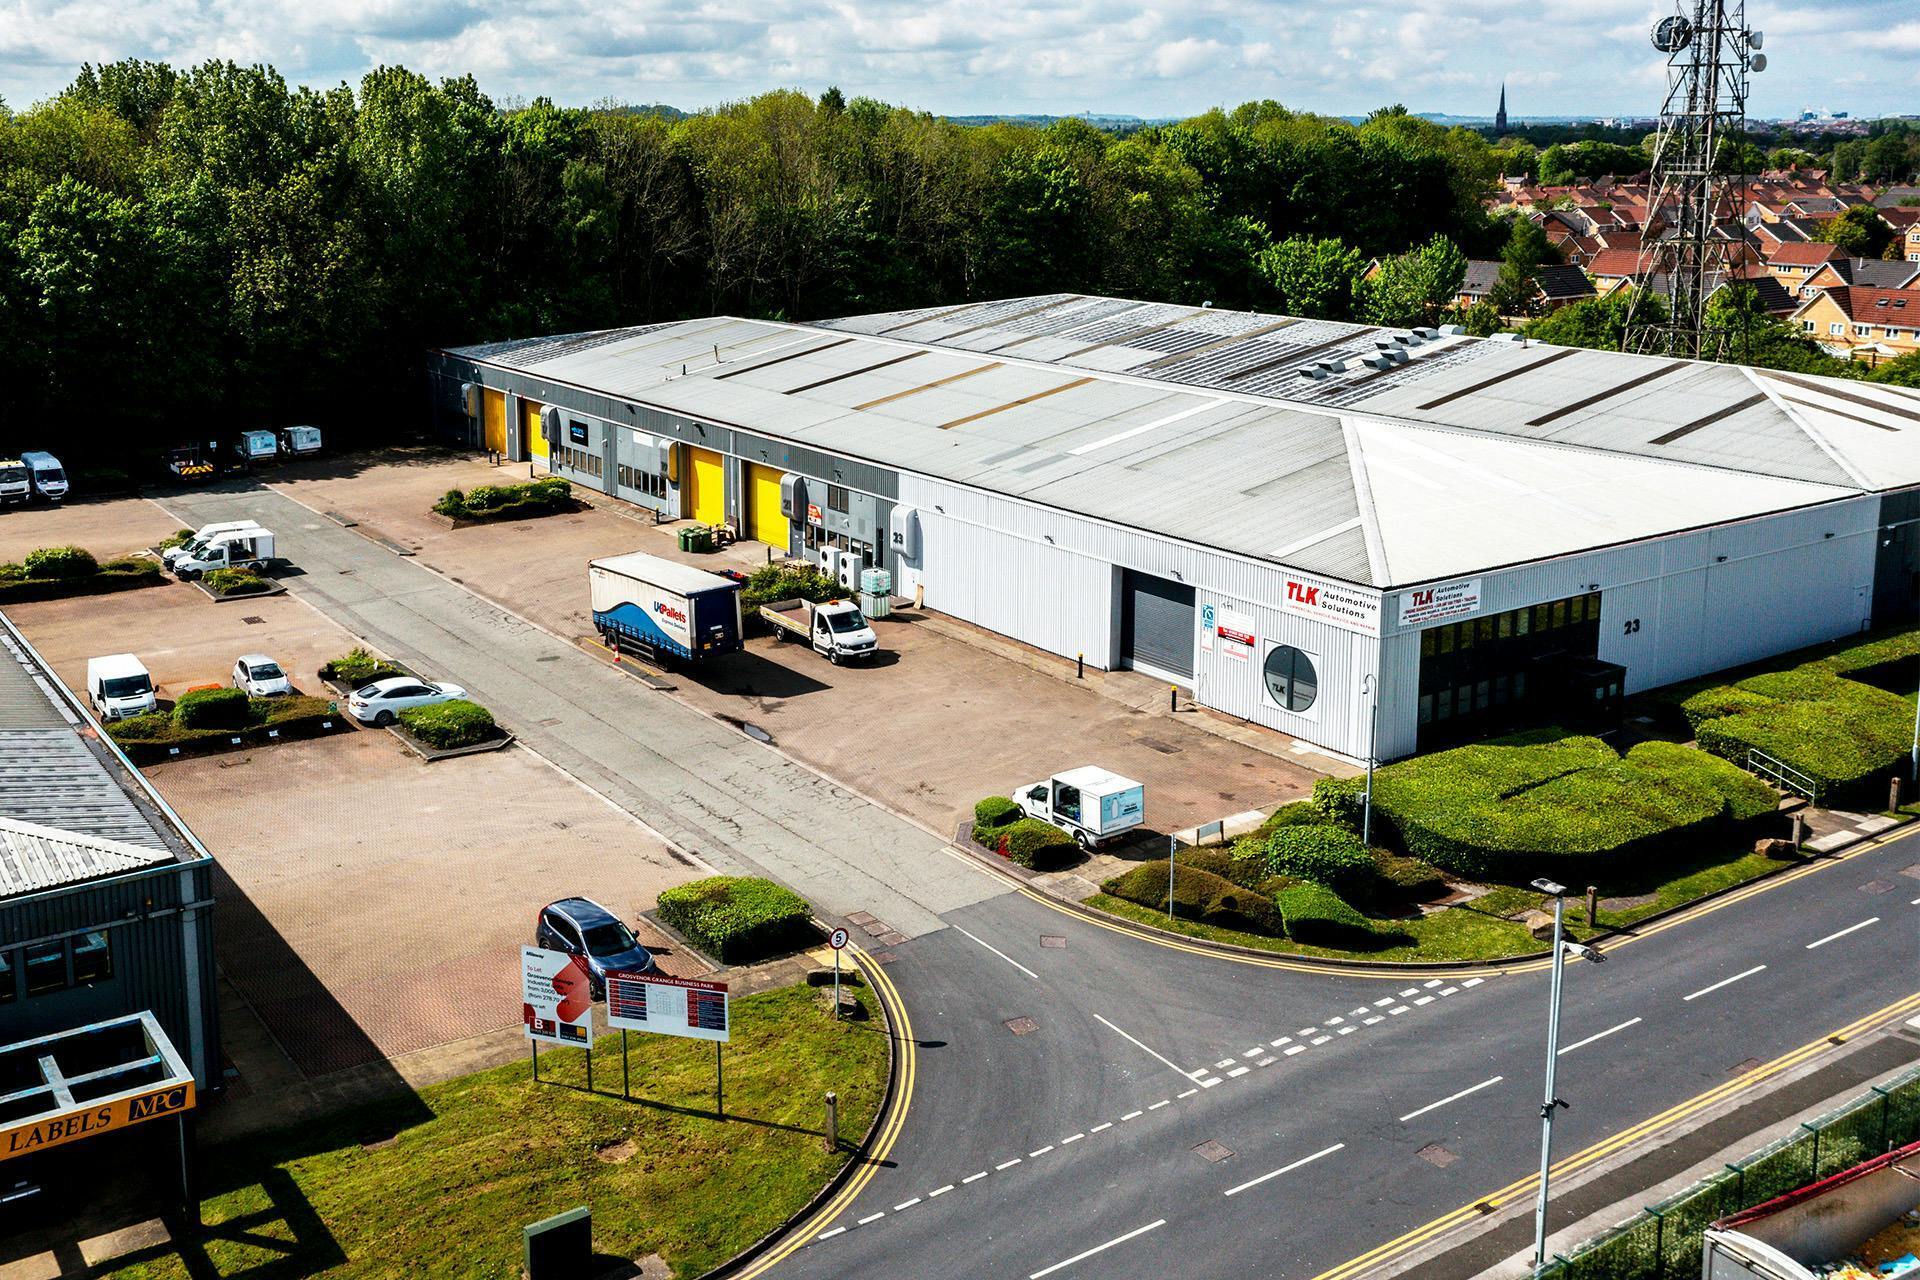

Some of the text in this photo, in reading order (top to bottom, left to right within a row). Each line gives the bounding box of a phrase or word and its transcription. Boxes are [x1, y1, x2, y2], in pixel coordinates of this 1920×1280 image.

[893, 531, 903, 544] 23
[1287, 581, 1320, 606] TLK
[1412, 588, 1435, 606] TLK
[1435, 592, 1463, 602] Solutions
[1436, 583, 1470, 593] Automotive
[1323, 591, 1377, 611] Automotive
[1321, 601, 1366, 620] Solutions
[1624, 618, 1641, 636] 23
[1272, 682, 1286, 695] TLK
[835, 932, 842, 943] 5
[618, 972, 651, 982] GROSVENOR
[651, 976, 674, 985] GRANGE
[674, 980, 700, 988] BUSINESS
[132, 1090, 184, 1119] MPC
[9, 1107, 113, 1153] LABELS
